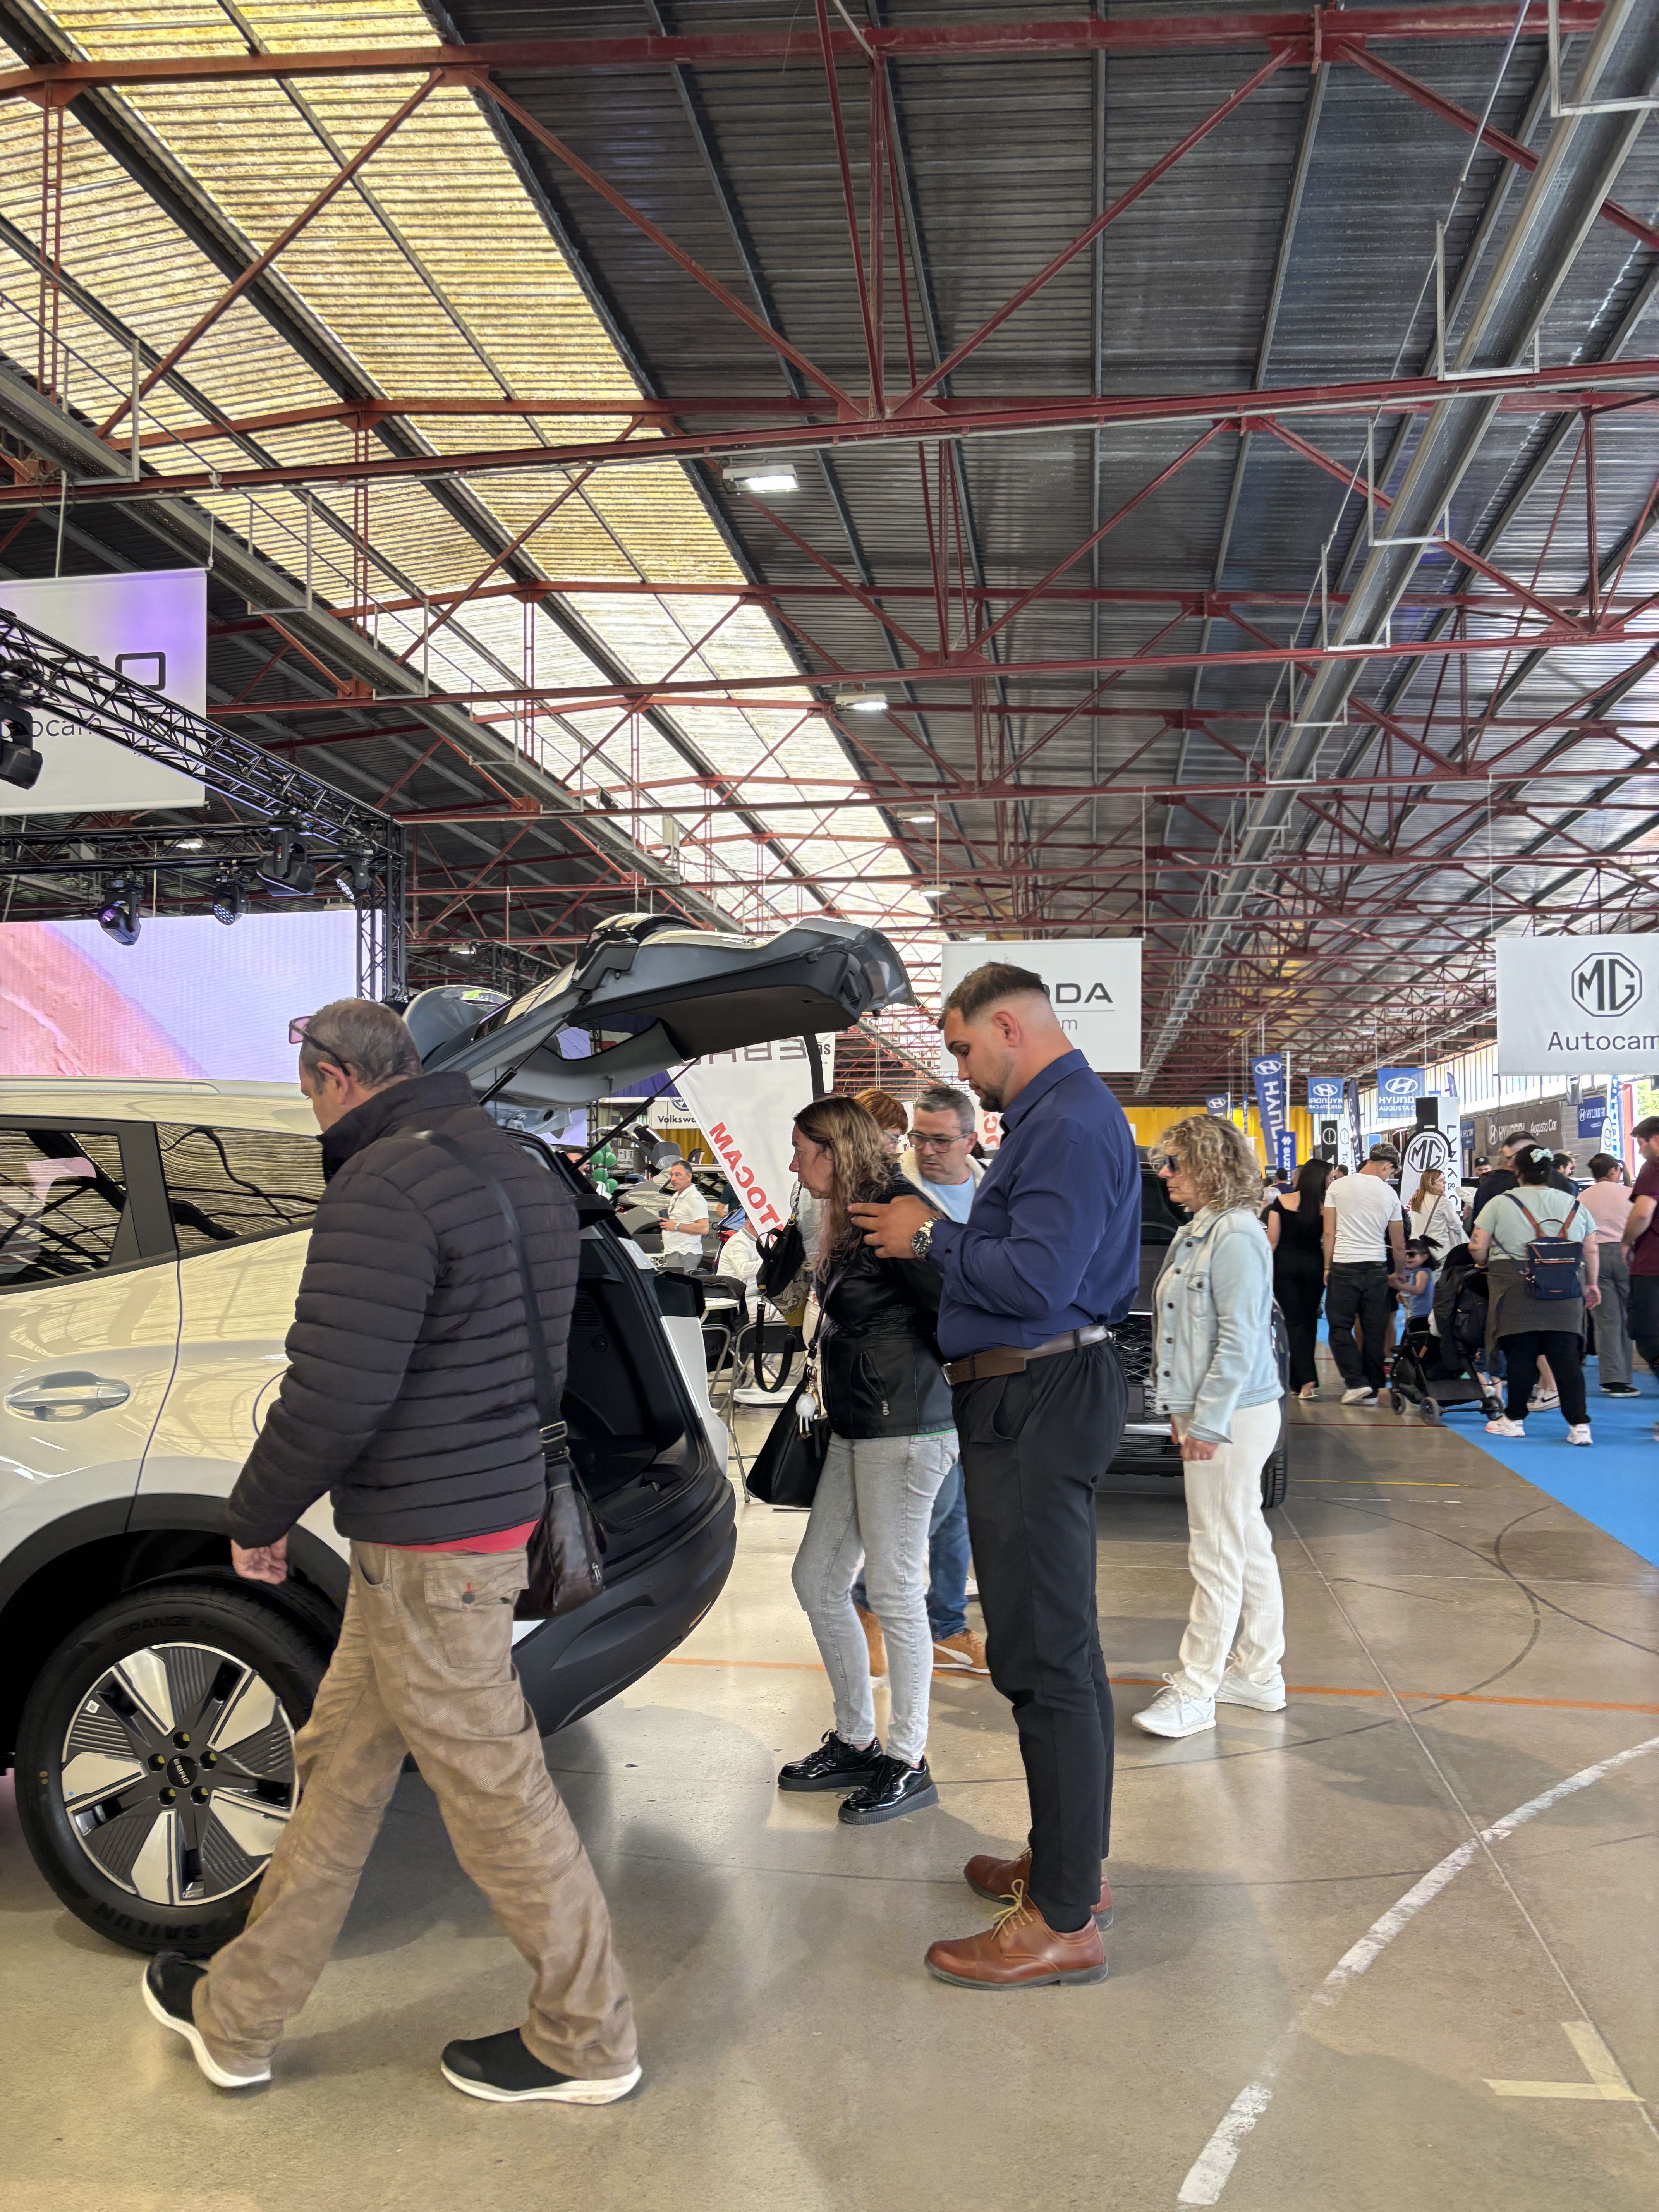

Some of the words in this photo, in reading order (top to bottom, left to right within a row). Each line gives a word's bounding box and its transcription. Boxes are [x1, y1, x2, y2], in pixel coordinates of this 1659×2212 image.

[1579, 958, 1635, 1011] MG
[1547, 1031, 1659, 1051] Autocam
[658, 1115, 697, 1123] Volkswa
[1411, 1139, 1443, 1170] MG
